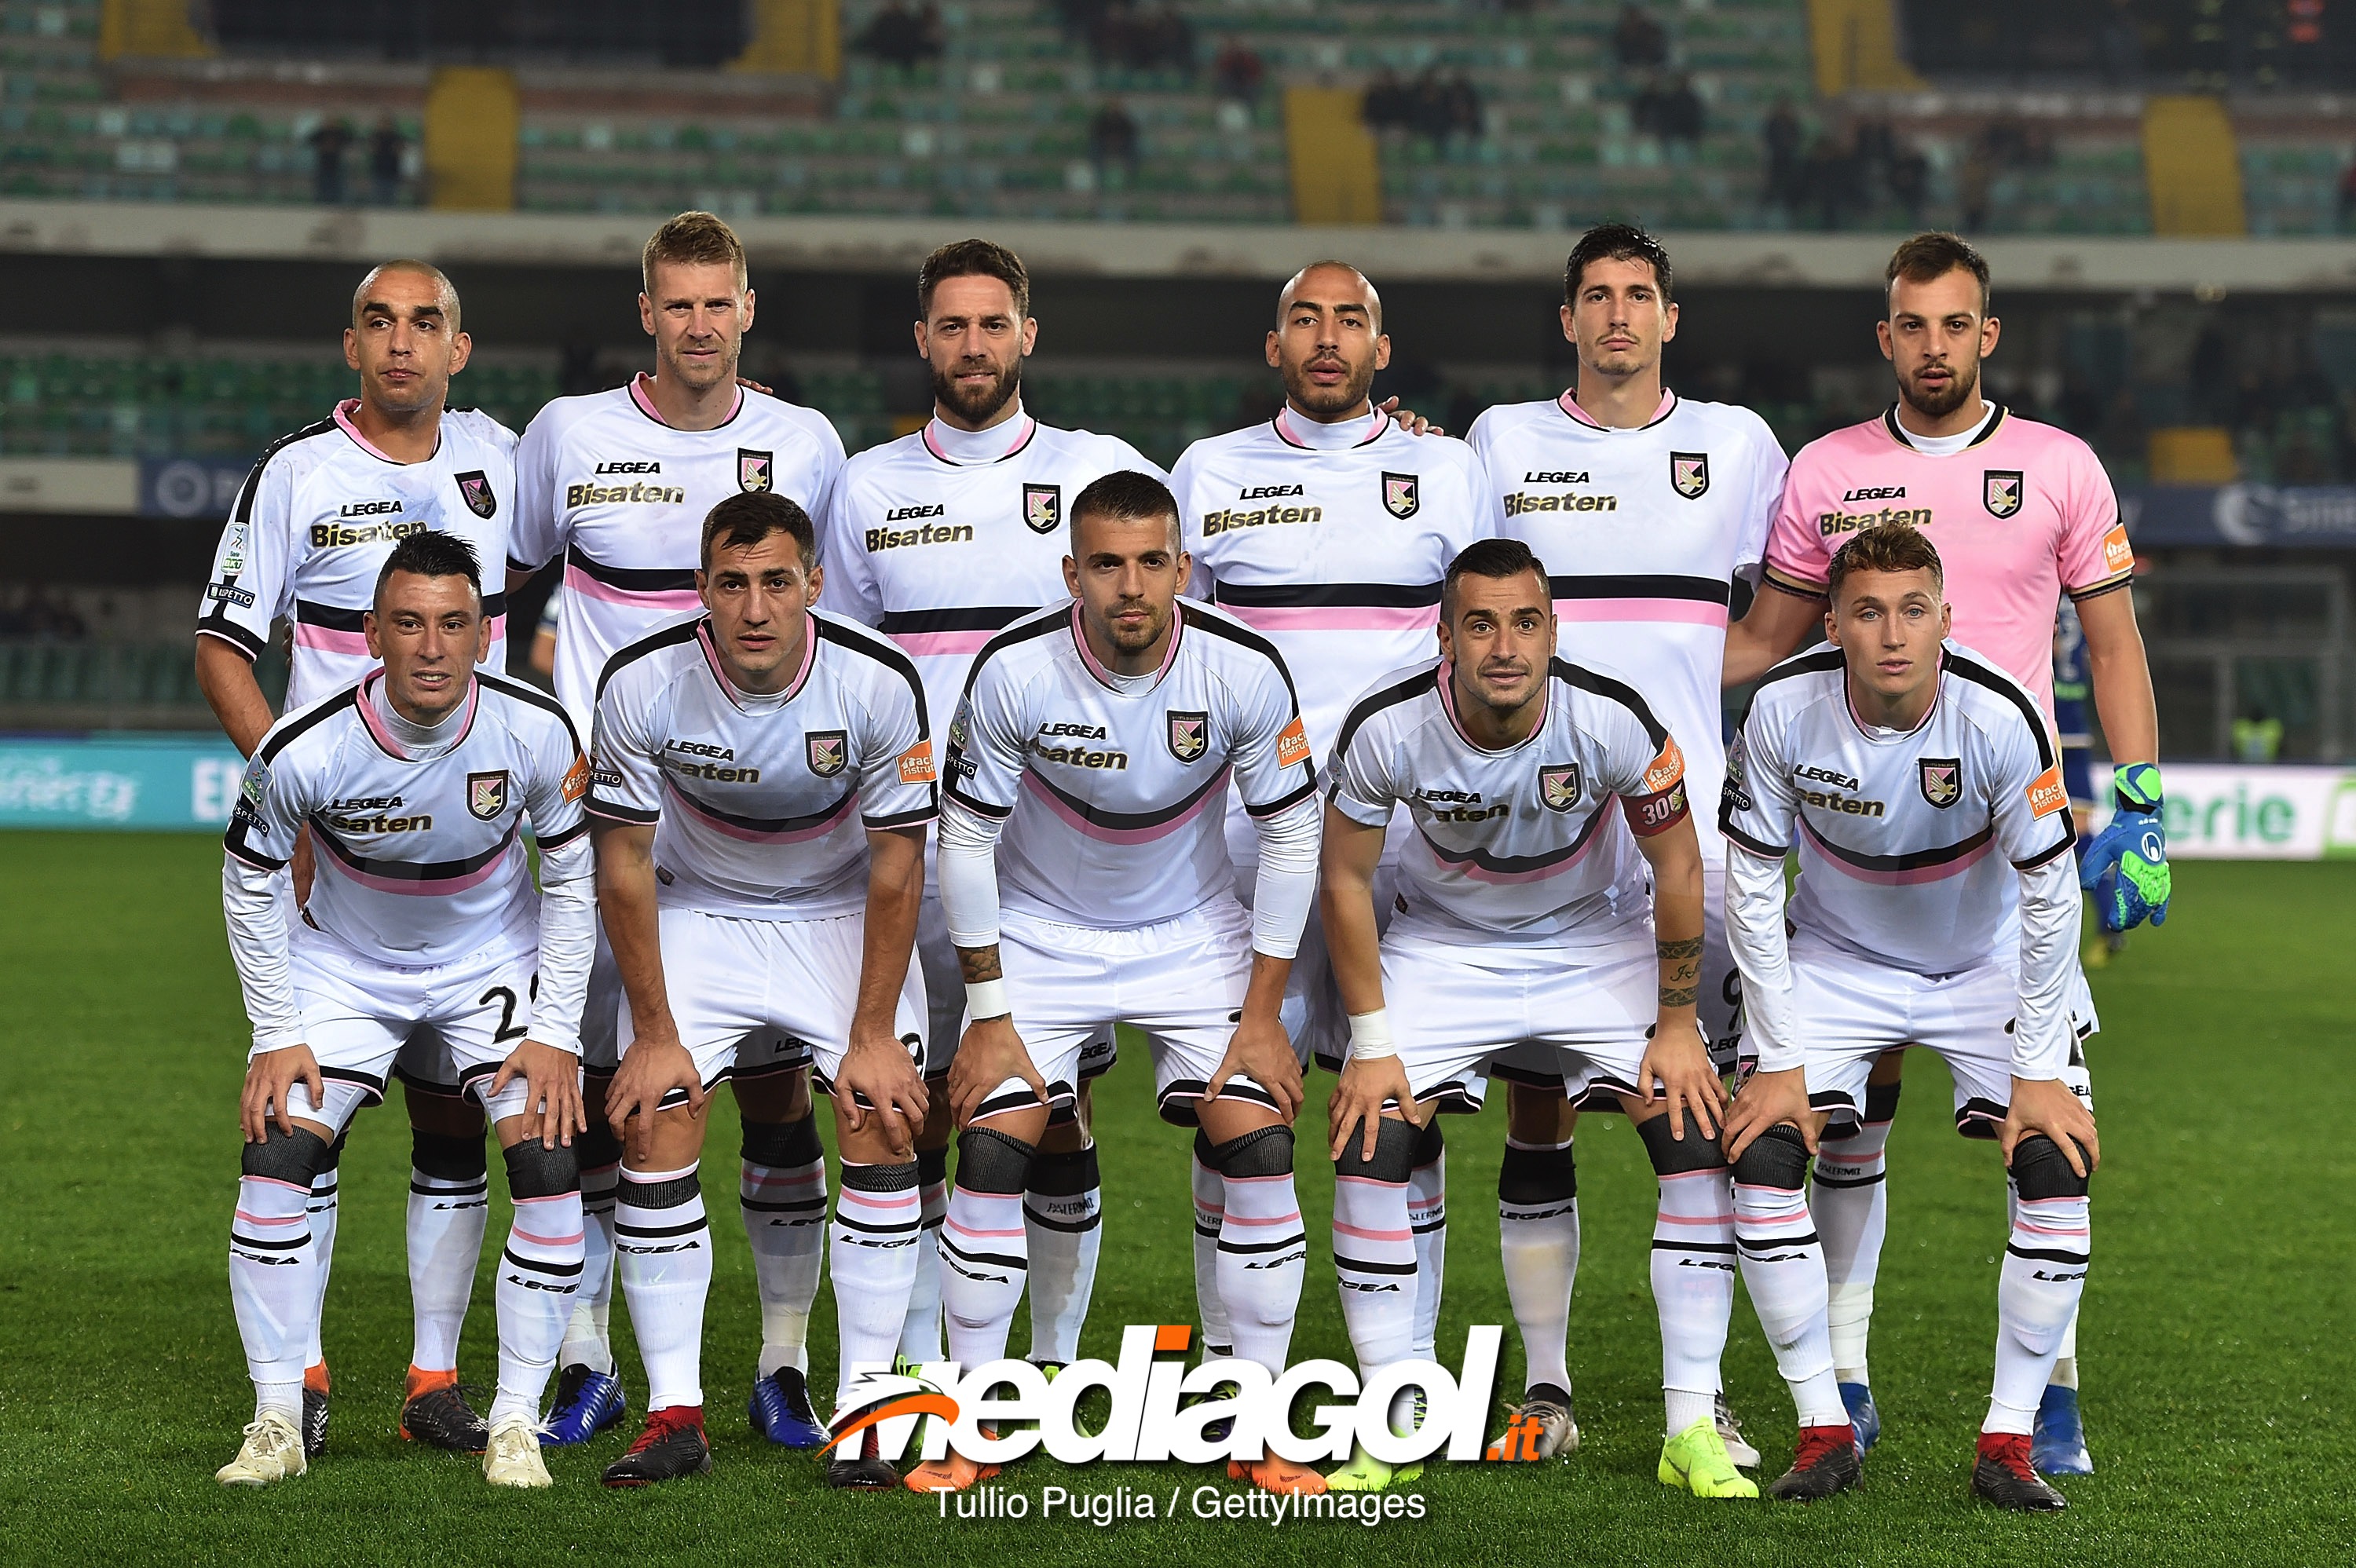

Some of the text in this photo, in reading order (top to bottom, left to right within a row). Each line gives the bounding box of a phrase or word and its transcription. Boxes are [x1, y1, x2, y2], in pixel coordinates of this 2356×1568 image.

[595, 462, 660, 475] LEGEA
[1524, 471, 1590, 484] LEGEA
[565, 481, 685, 511] Bisaten
[1239, 484, 1304, 501] LEGEA
[1842, 486, 1907, 503] LEGEA
[340, 501, 403, 517] LEGEA
[886, 503, 945, 522] LEGEA
[1502, 491, 1618, 519] Bisaten
[1202, 503, 1323, 538] Bisaten
[1819, 506, 1933, 537] Bisaten
[310, 520, 429, 548] Bisaten
[865, 522, 975, 554] Bisaten
[1037, 722, 1107, 740] LEGEA
[665, 738, 734, 762] LEGEA
[1034, 745, 1129, 770] saten
[665, 758, 760, 784] saten
[904, 764, 935, 777] ristrut
[946, 753, 975, 776] SPETTO
[590, 769, 620, 784] PETTO
[1793, 763, 1859, 791] LEGEA
[331, 796, 404, 810] LEGEA
[1412, 787, 1482, 804] LEGEA
[1723, 787, 1750, 809] SPETTO
[2035, 789, 2065, 811] ristrut
[234, 804, 268, 834] ISPETTO
[1436, 803, 1509, 823] aten
[1642, 797, 1670, 825] 30
[334, 813, 432, 834] saten
[1079, 1041, 1111, 1061] EGE
[1710, 1033, 1741, 1052] LEG
[1047, 1197, 1095, 1215] PALERMO
[1500, 1205, 1574, 1220] LEGEA
[840, 1234, 921, 1248] LEGE
[507, 1274, 580, 1295] LEGE
